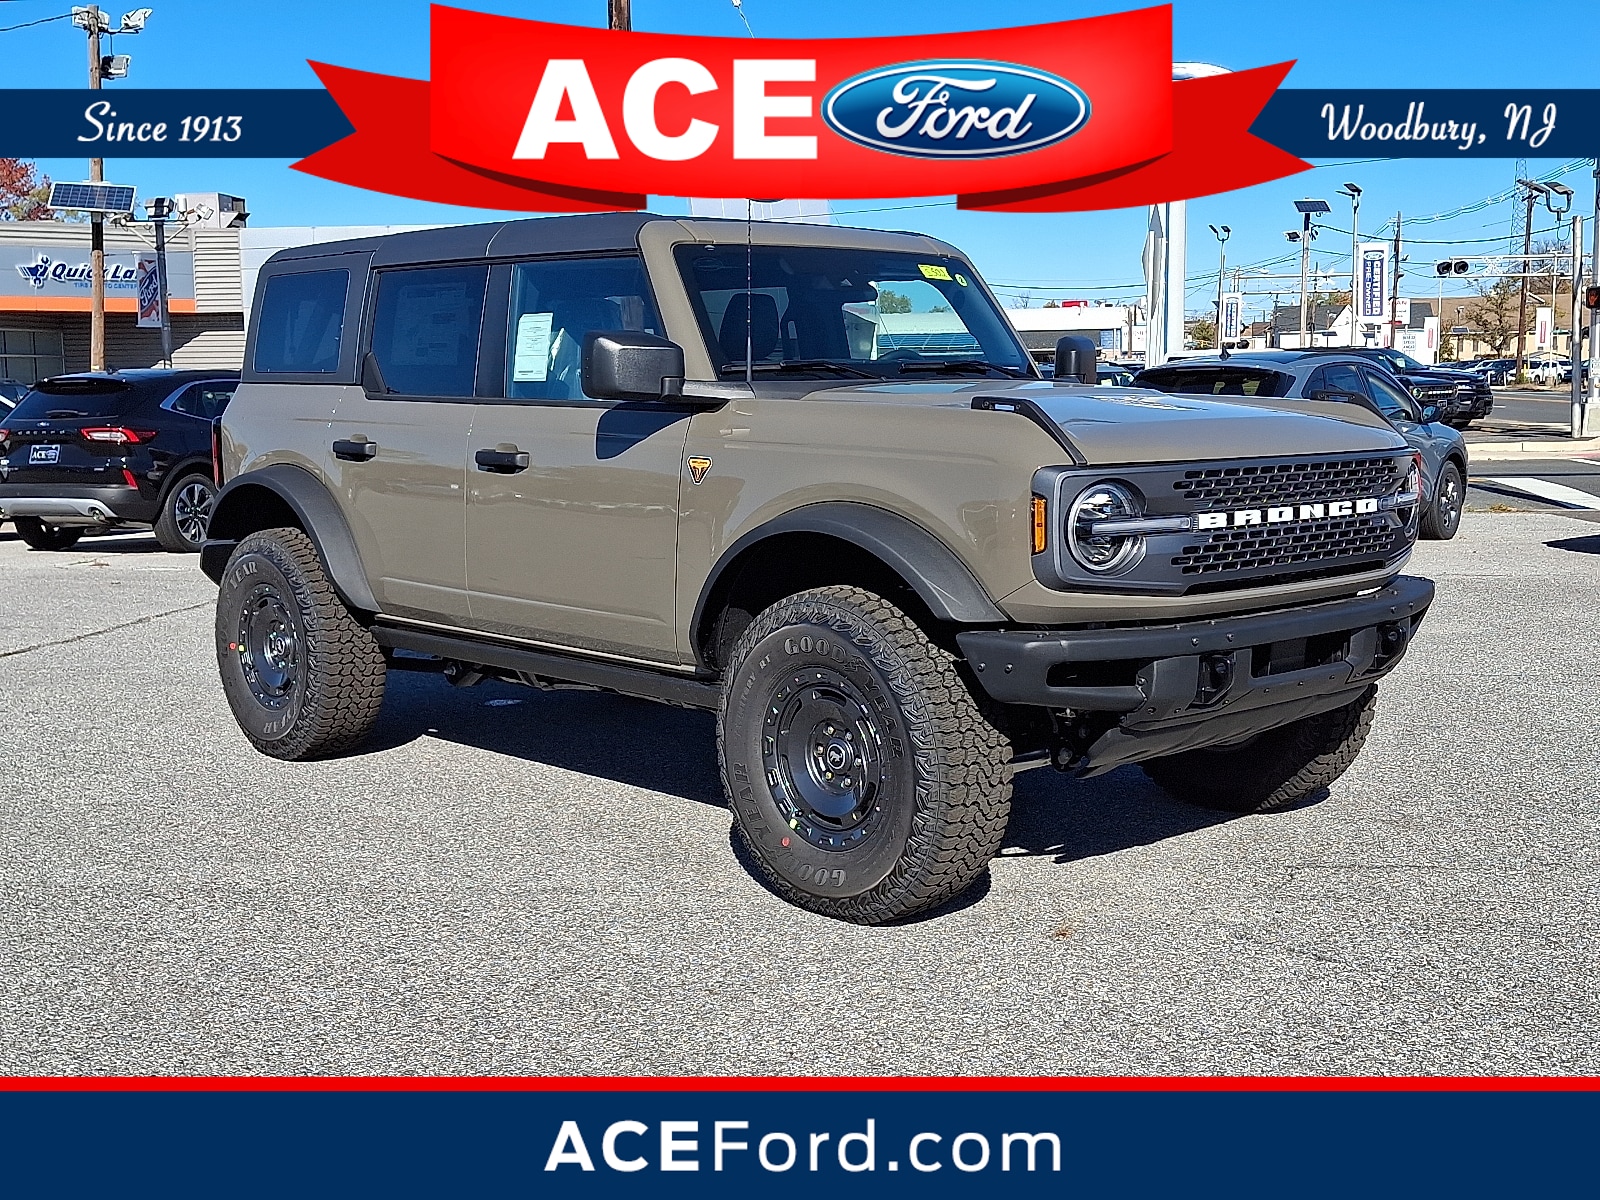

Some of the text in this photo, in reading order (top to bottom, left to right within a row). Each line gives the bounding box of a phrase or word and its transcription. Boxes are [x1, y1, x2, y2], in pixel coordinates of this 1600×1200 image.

[140, 273, 158, 306] Ford
[1198, 498, 1378, 530] BRONCO
[784, 635, 905, 759] GOODYEAR
